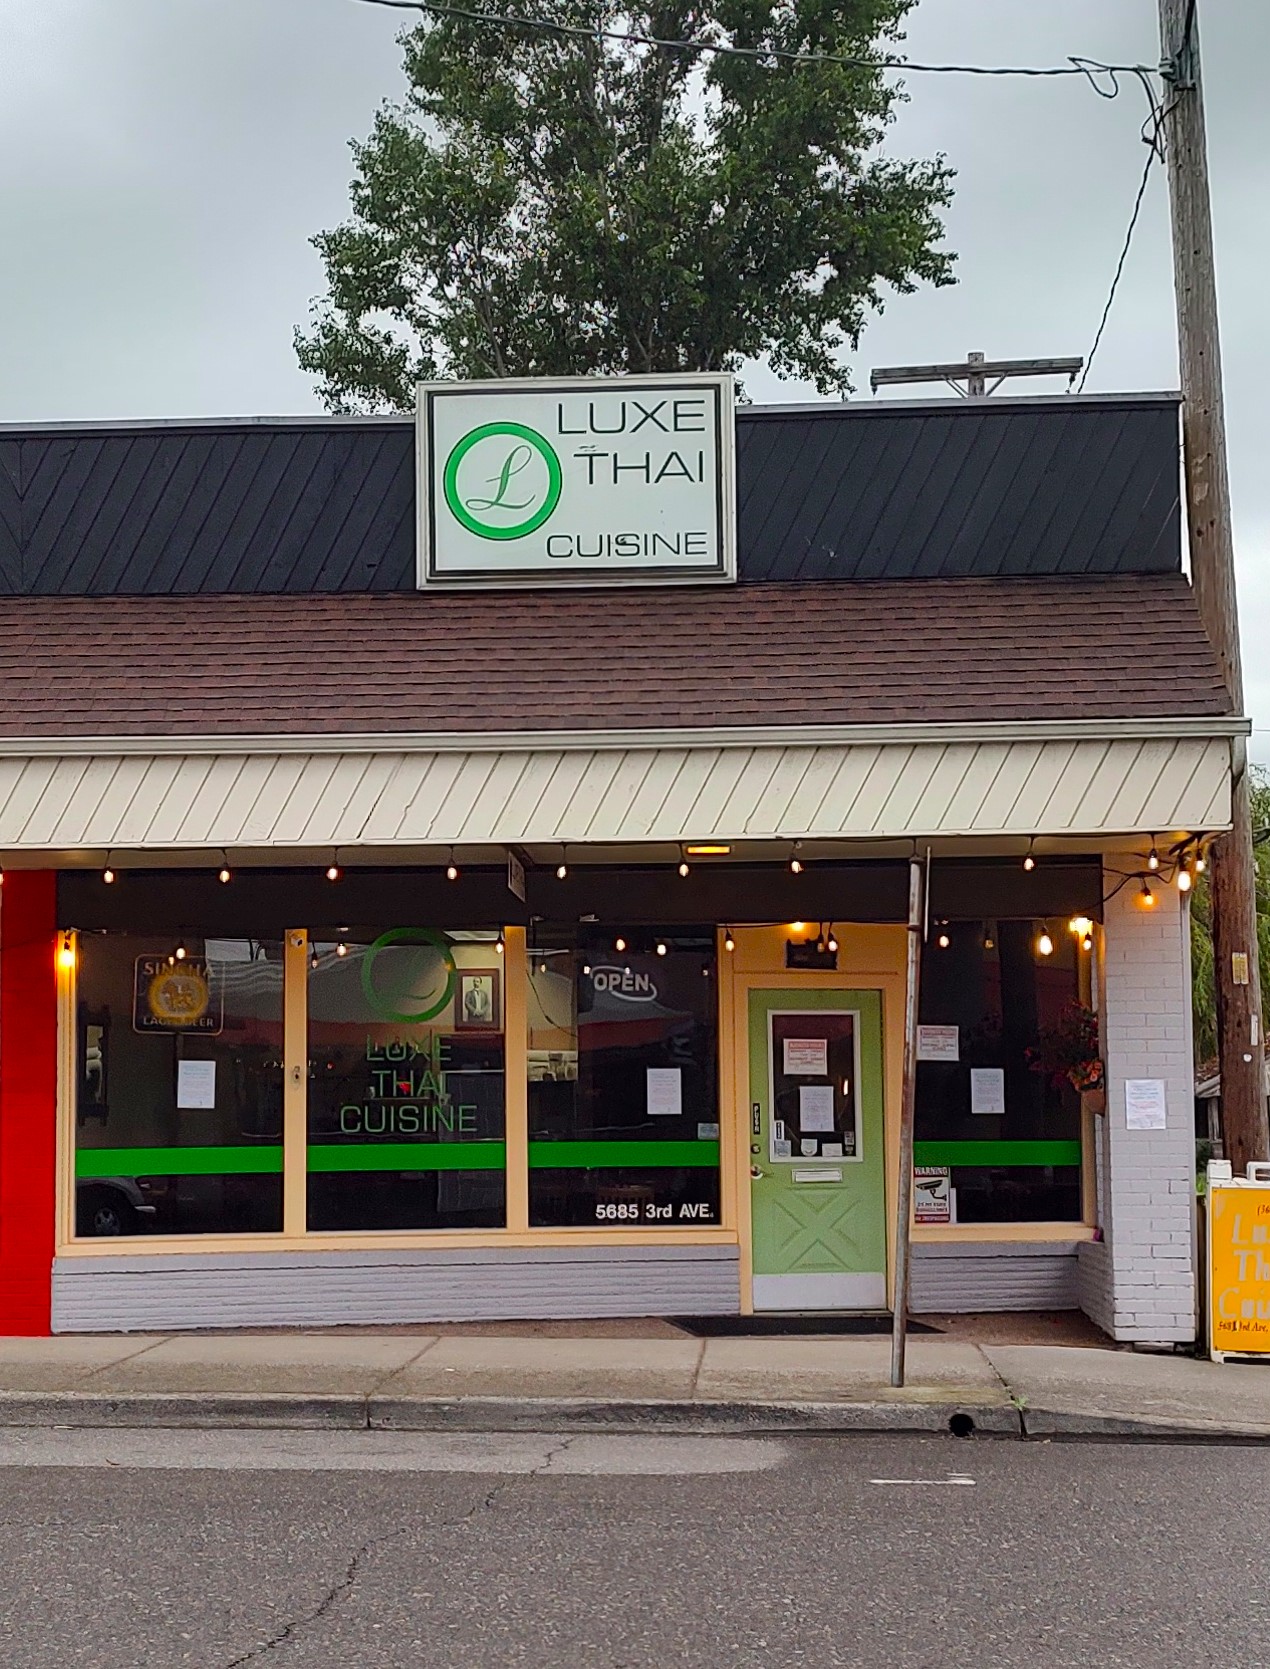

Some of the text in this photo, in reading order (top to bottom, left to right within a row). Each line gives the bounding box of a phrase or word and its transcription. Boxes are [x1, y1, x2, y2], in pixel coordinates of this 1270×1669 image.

[557, 400, 706, 435] LUXE
[573, 450, 704, 485] THAI
[546, 532, 708, 559] CUISINE
[594, 973, 649, 992] OPEN
[366, 1034, 452, 1061] LUXE
[371, 1070, 447, 1097] THAI
[340, 1105, 478, 1133] CUISINE
[595, 1203, 639, 1220] 5685
[645, 1203, 673, 1219] 3rd
